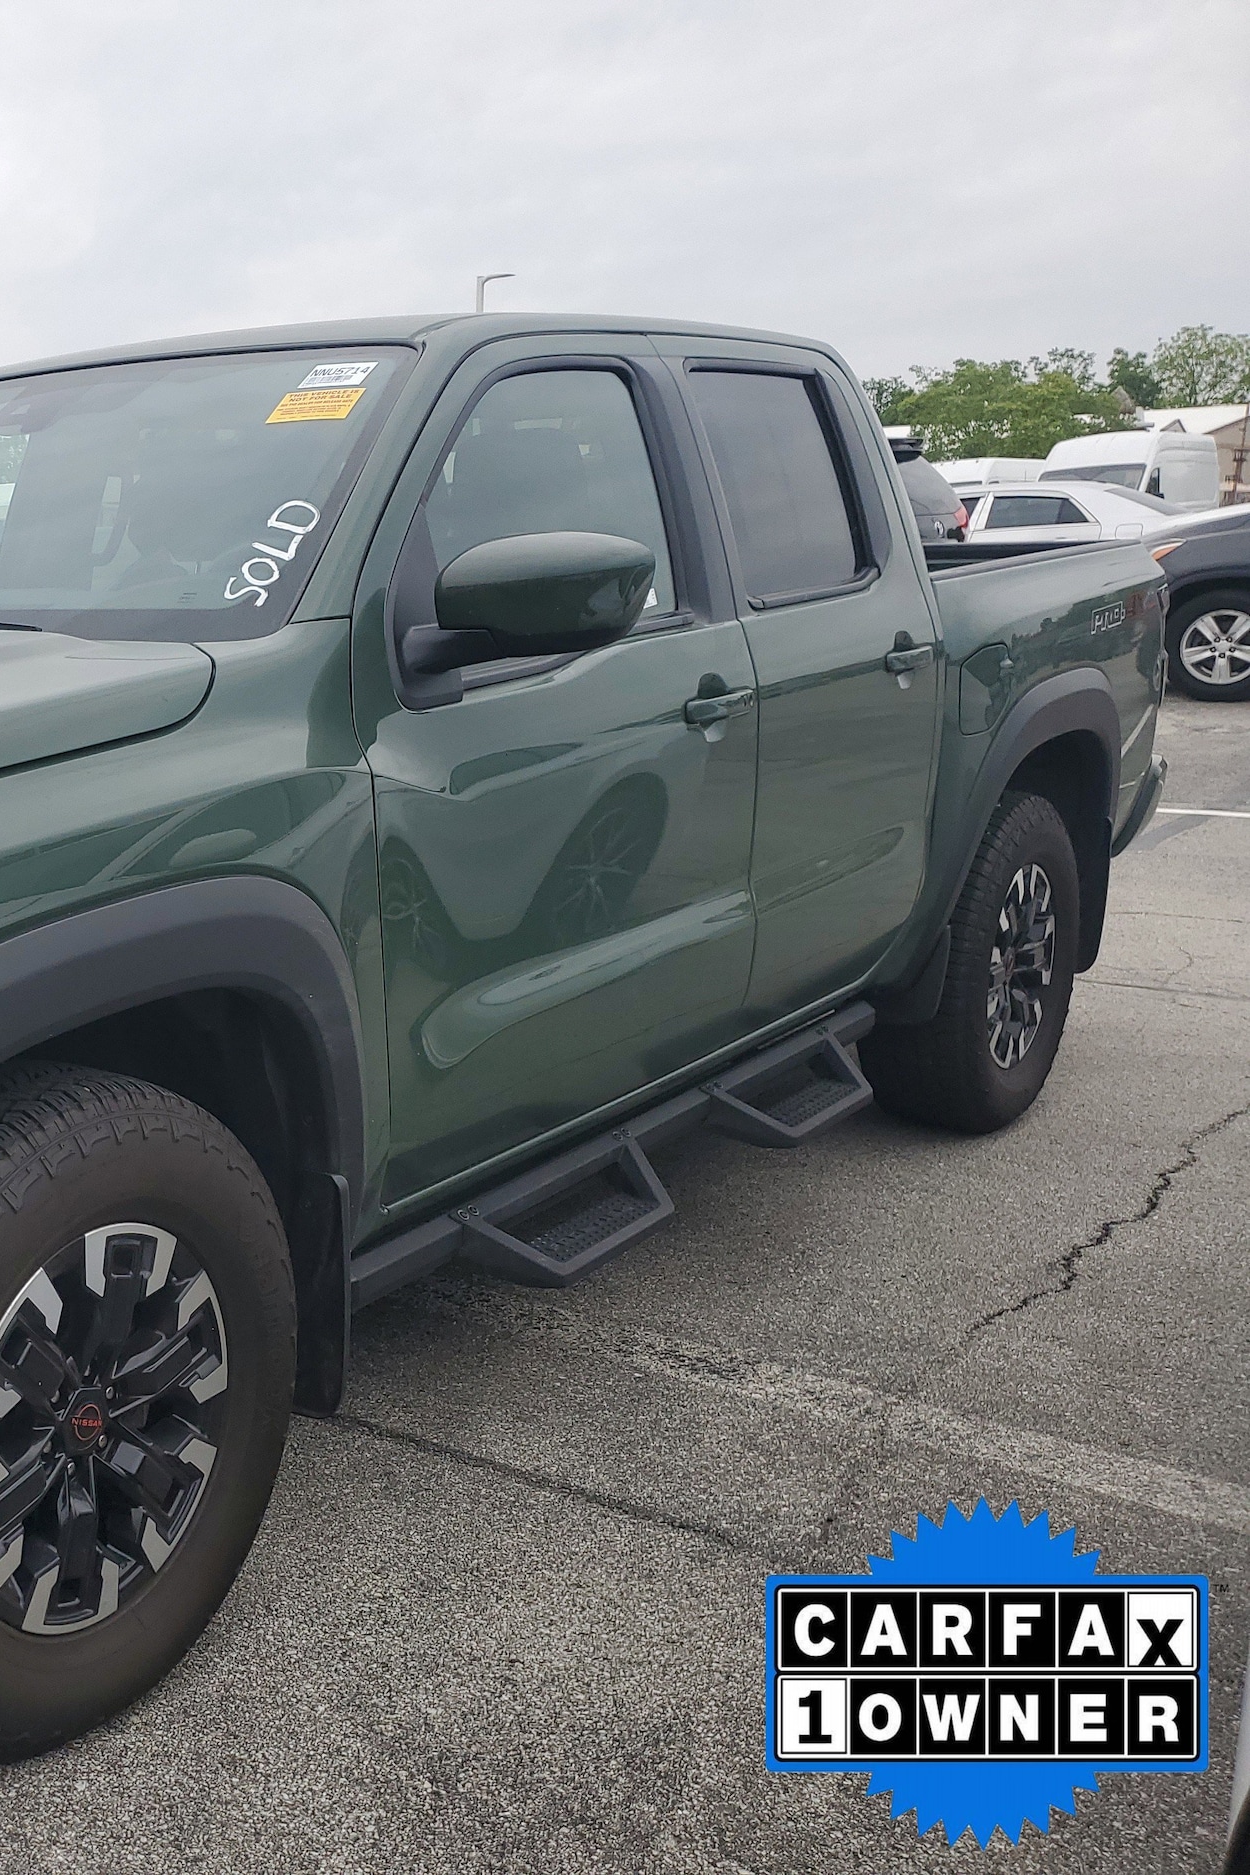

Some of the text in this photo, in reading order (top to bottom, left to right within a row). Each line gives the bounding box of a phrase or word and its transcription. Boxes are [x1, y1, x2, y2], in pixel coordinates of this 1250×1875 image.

[310, 366, 370, 377] NNU5714
[224, 500, 321, 607] SOLD
[71, 1417, 103, 1427] NISSAN
